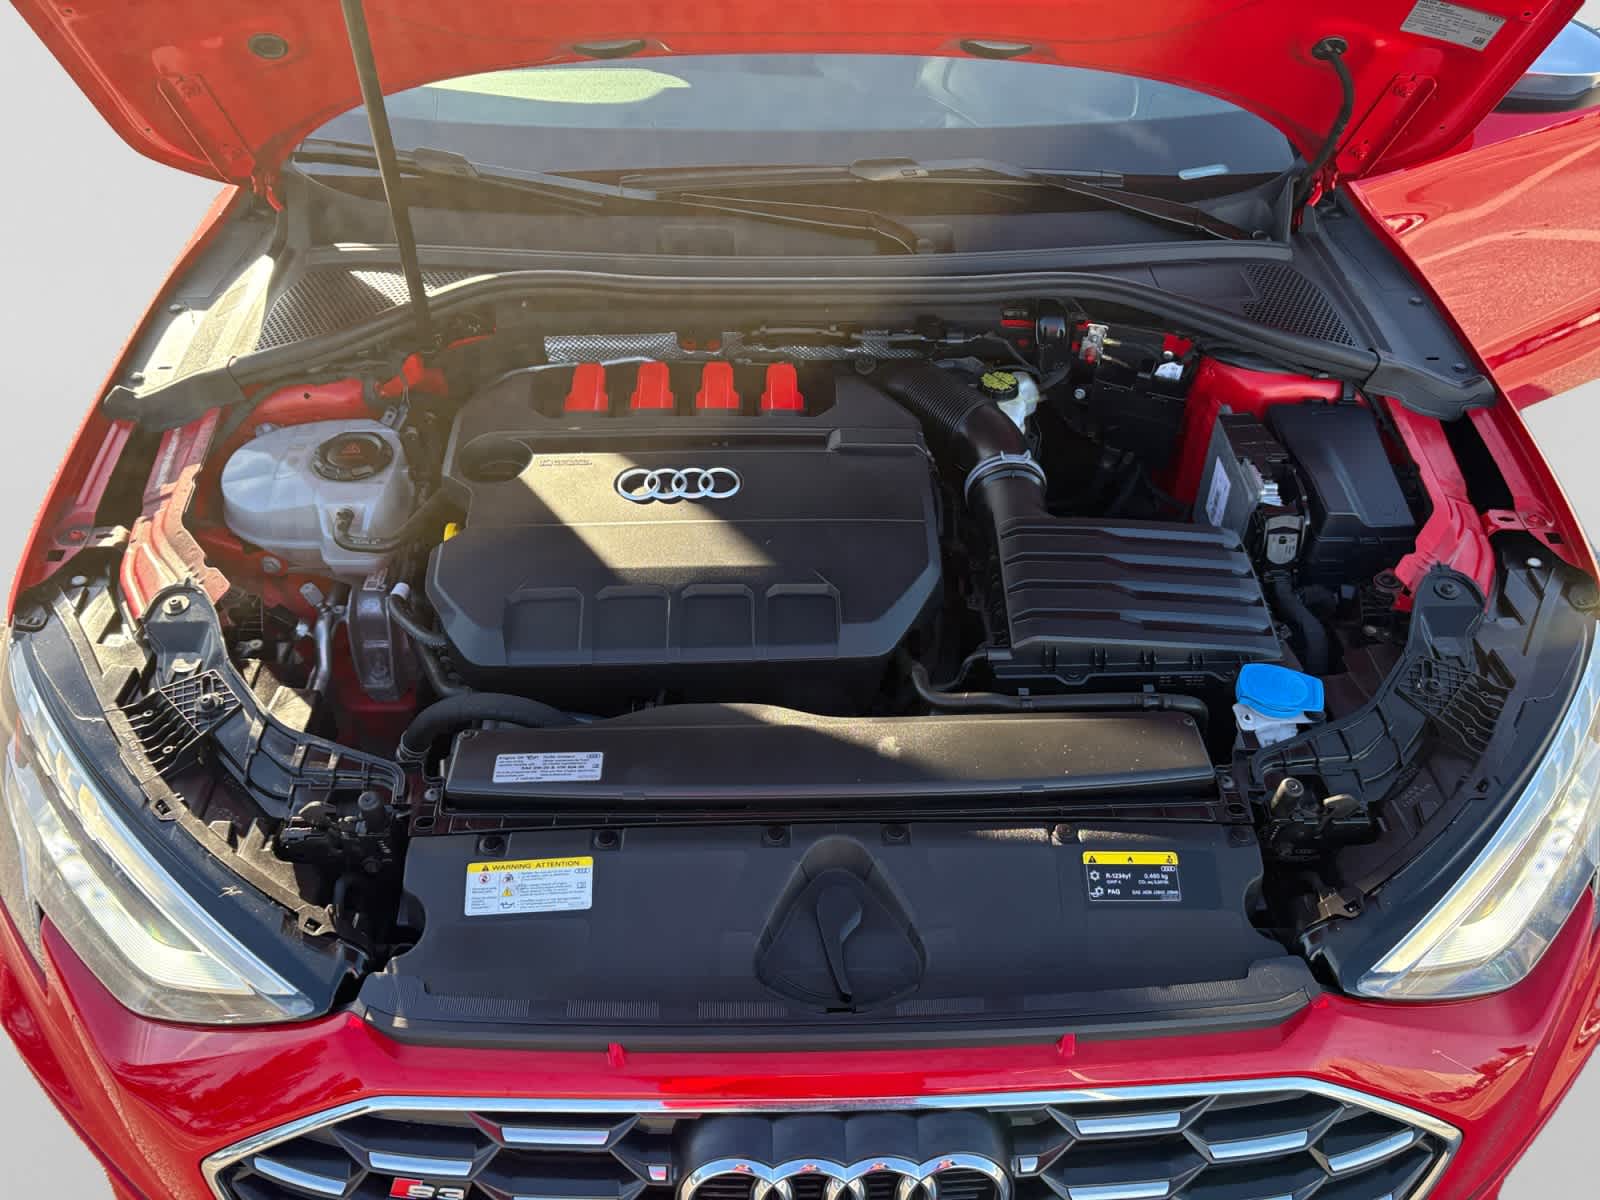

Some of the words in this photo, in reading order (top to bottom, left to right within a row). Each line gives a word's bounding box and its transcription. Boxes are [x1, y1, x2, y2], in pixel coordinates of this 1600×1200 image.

[491, 863, 532, 871] WARNING
[535, 860, 580, 868] ATTENTION
[407, 1185, 465, 1200] S3
